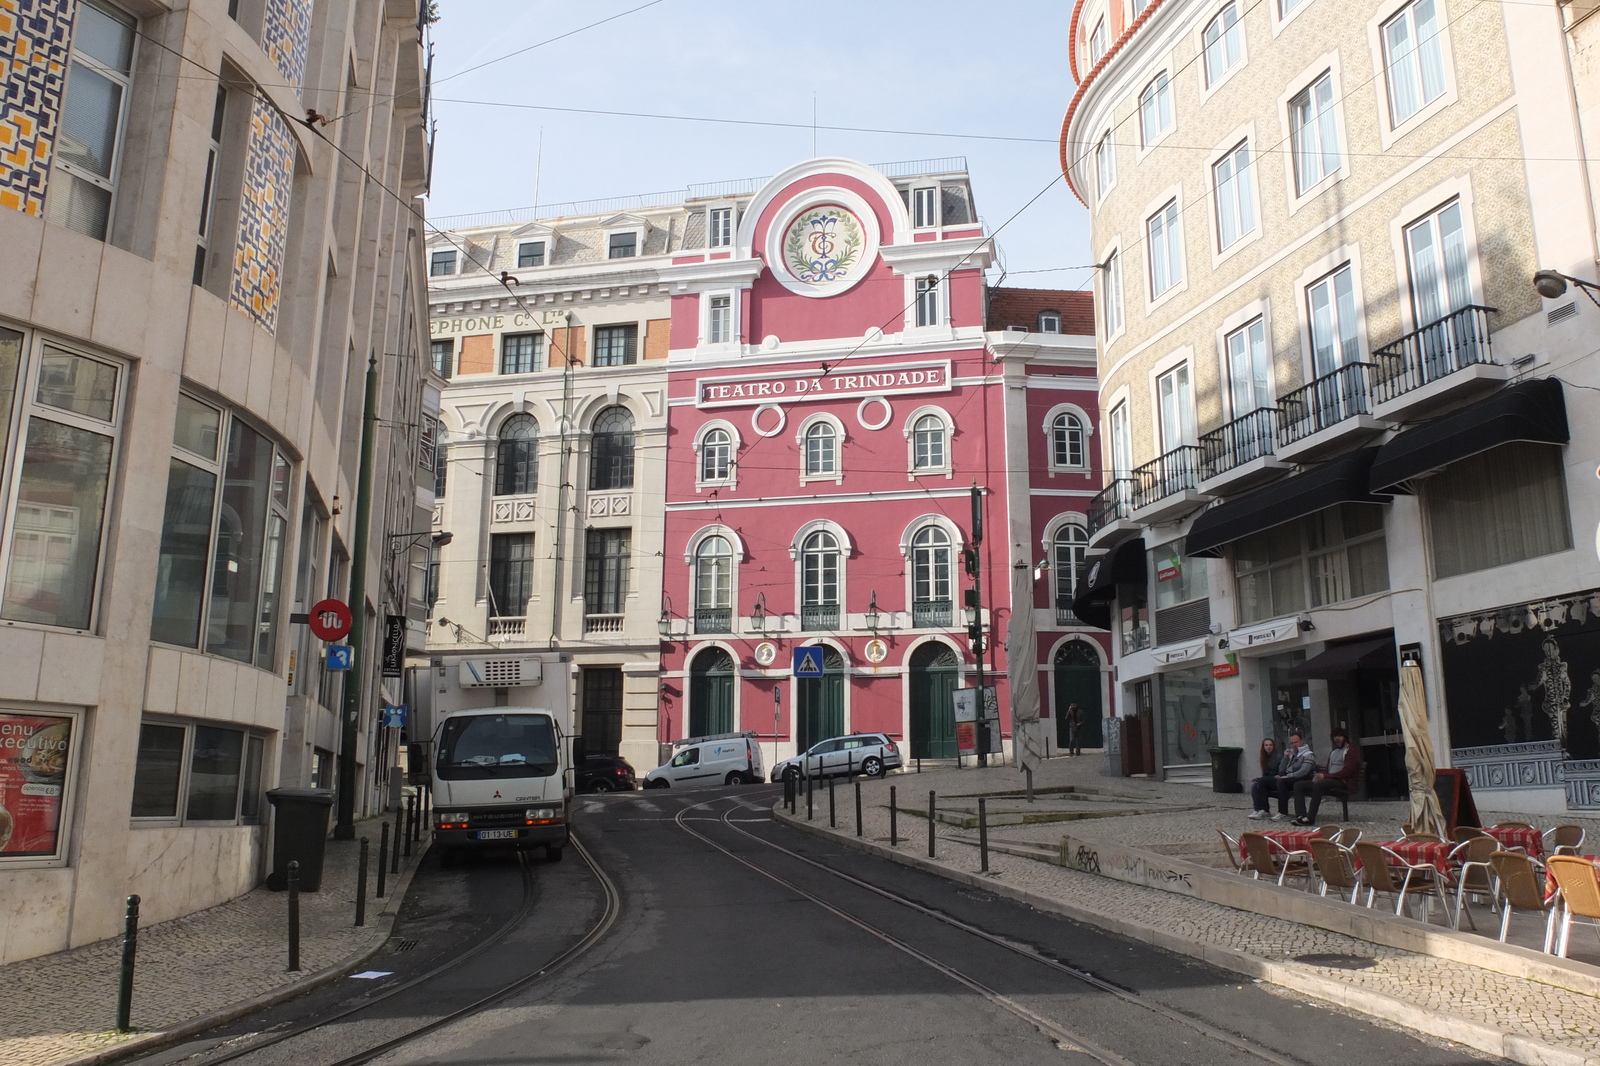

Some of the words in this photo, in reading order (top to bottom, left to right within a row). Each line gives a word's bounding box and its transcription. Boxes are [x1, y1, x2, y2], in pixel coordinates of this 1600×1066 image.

[706, 381, 786, 399] TEATRO
[795, 378, 823, 393] DA
[830, 370, 940, 390] TRINDADE
[390, 624, 400, 667] LIMONCELLO
